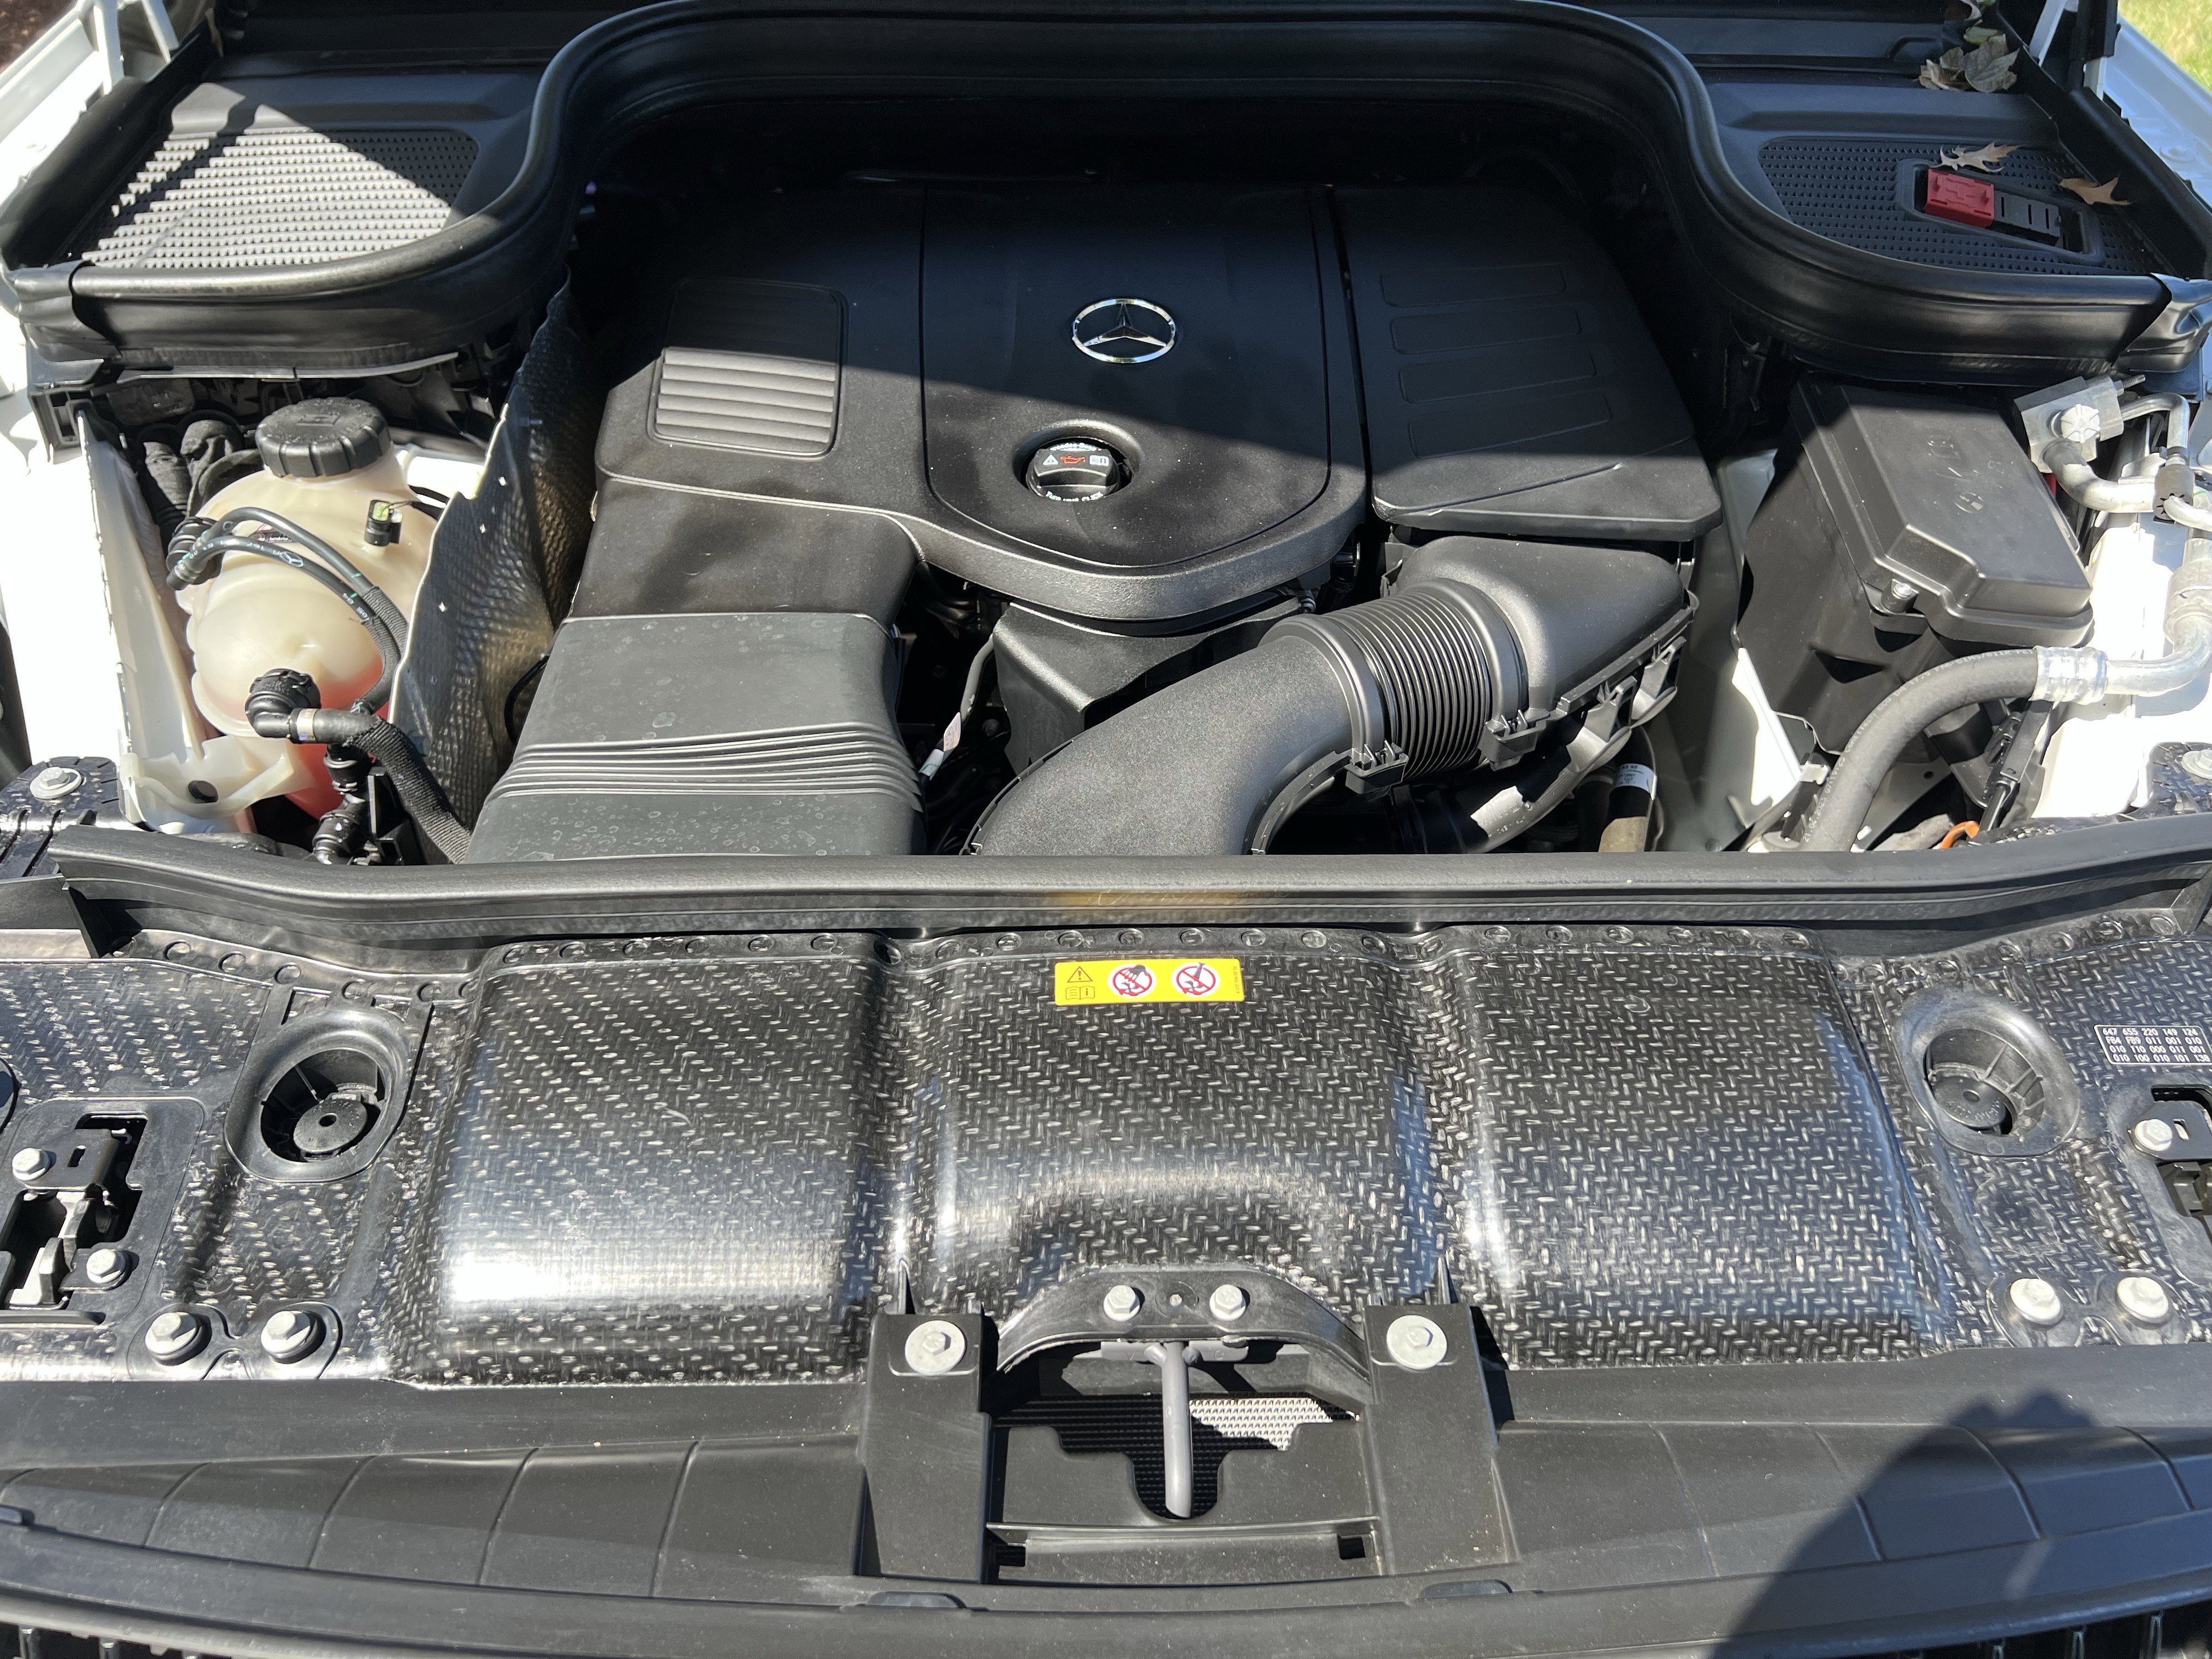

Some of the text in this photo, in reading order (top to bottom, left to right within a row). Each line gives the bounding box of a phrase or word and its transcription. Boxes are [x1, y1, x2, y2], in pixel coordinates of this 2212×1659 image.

[2102, 1028, 2118, 1036] 647
[2141, 1028, 2159, 1036] 220
[2162, 1028, 2178, 1036] 149
[2182, 1028, 2198, 1036] 124
[2145, 1036, 2162, 1045] 011
[2165, 1036, 2182, 1045] 001
[2185, 1036, 2202, 1045] 010
[2109, 1045, 2207, 1054] 010 110 000 011 001
[2113, 1054, 2130, 1063] 010
[2134, 1054, 2151, 1063] 100
[2153, 1054, 2170, 1063] 010
[2174, 1054, 2191, 1063] 101
